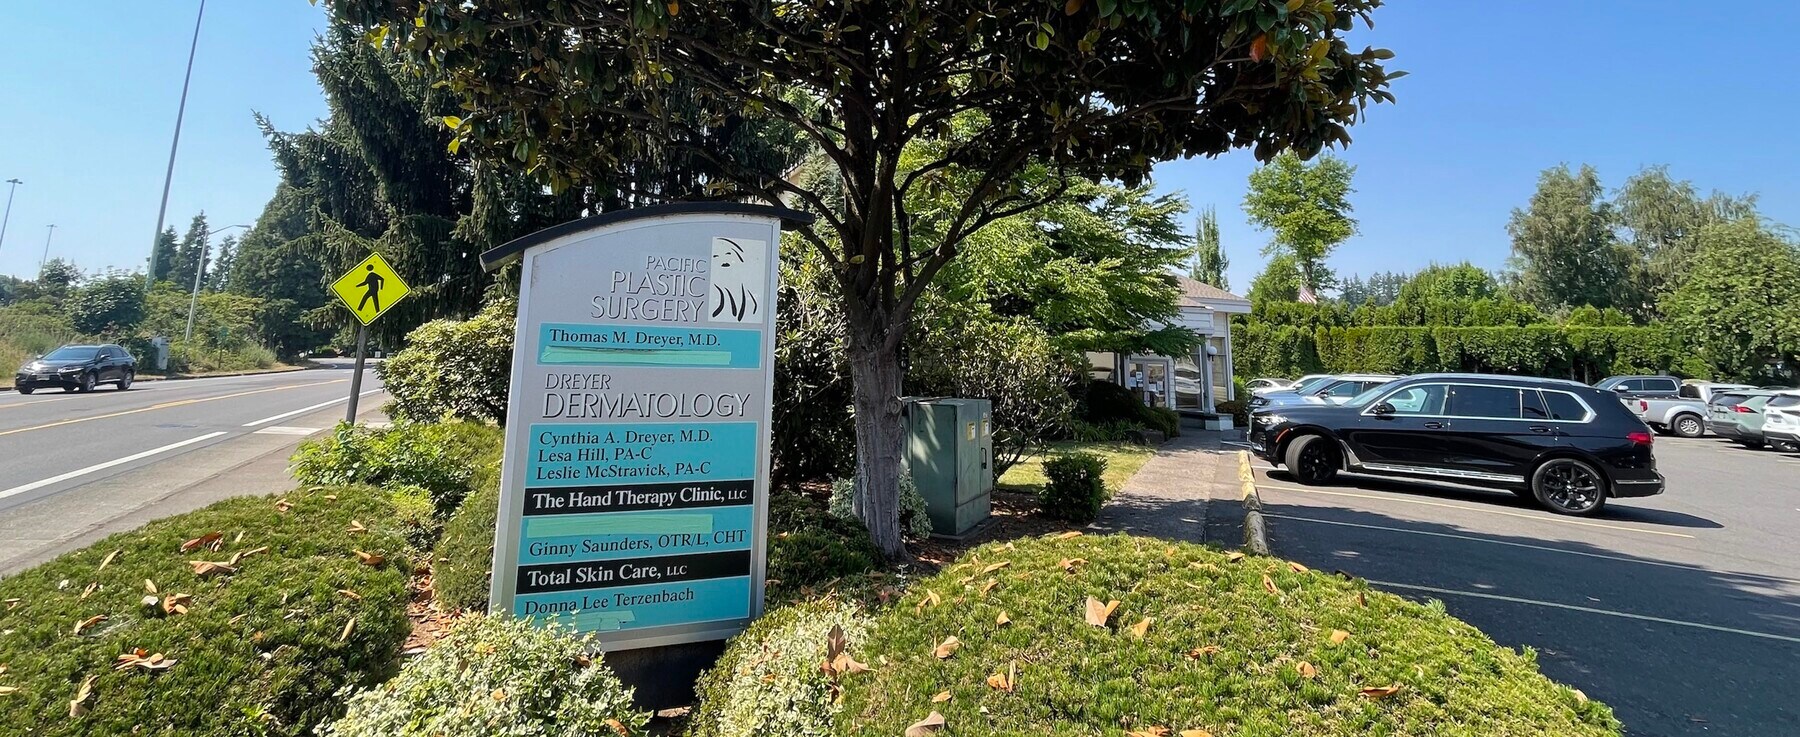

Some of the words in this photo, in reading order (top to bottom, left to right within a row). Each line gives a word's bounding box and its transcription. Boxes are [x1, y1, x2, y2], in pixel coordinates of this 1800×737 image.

[646, 255, 707, 274] PACIFIC
[610, 270, 706, 298] PLASTIC
[590, 295, 705, 323] SURGERY
[549, 329, 608, 344] Thomas
[611, 331, 630, 345] M.
[635, 332, 684, 348] Dreyer,
[688, 333, 721, 346] M.D.
[545, 373, 612, 390] DREYER
[542, 392, 751, 419] DERMATOLOGY
[539, 431, 599, 447] Cynthia
[604, 431, 620, 444] A.
[625, 430, 676, 446] Dreyer,
[680, 430, 713, 442] M.D.
[538, 448, 572, 463] Lesa
[577, 447, 609, 464] Hill,
[614, 446, 652, 461] PA-C
[536, 465, 580, 480] Leslie
[585, 463, 670, 479] McStravick,
[674, 461, 711, 475] PA-C
[532, 493, 564, 509] The
[568, 491, 612, 508] Hand
[615, 489, 677, 507] Therapy
[679, 486, 725, 503] Clinic,
[728, 489, 747, 500] LLC
[529, 541, 577, 558] Ginny
[581, 538, 652, 554] Saunders,
[658, 533, 709, 548] OTR/L,
[713, 530, 747, 544] CHT
[527, 569, 571, 587] Total
[575, 566, 614, 583] Skin
[618, 564, 661, 580] Care,
[666, 565, 687, 576] LLC
[524, 598, 577, 615] Donna
[582, 595, 609, 610] Lee
[613, 588, 694, 607] Terzenbach
